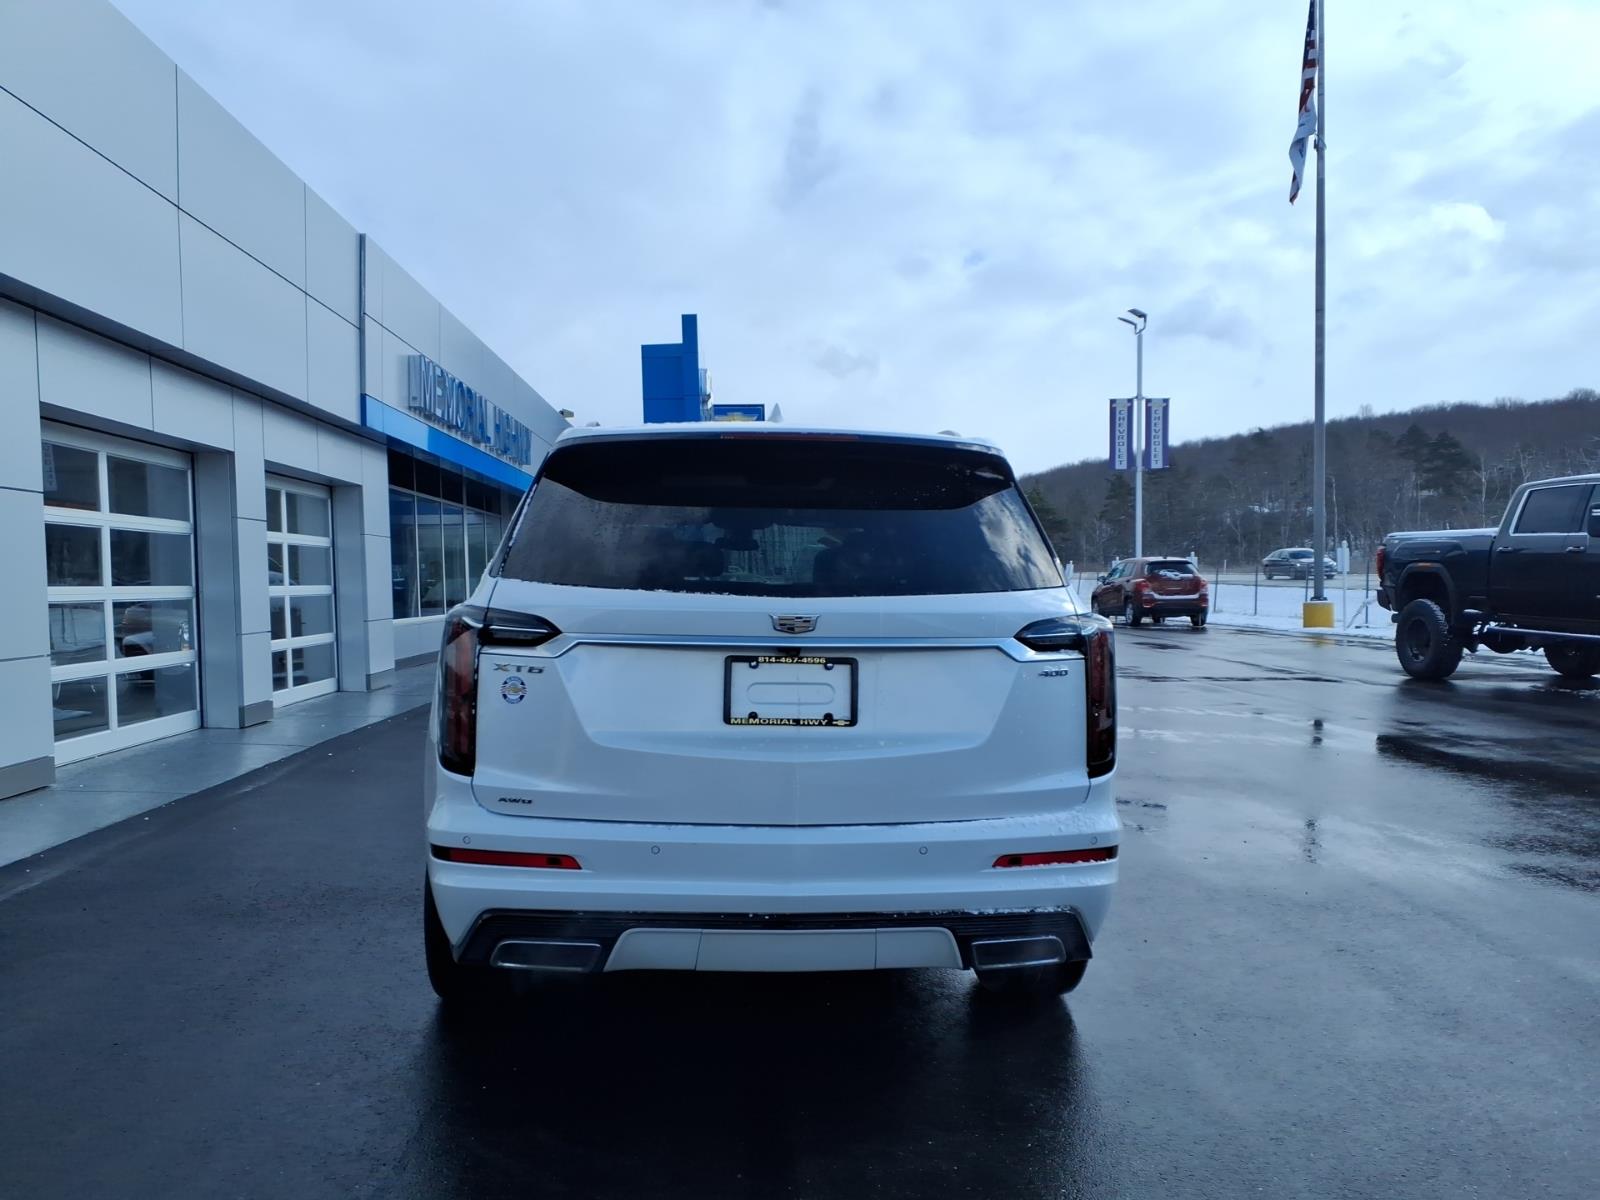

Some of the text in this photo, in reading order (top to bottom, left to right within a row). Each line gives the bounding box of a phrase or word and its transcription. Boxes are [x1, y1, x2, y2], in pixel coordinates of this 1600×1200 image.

[411, 355, 491, 444] MEMORIAL
[1117, 409, 1126, 465] CHEVROLET
[1152, 409, 1161, 465] CHEVROLET
[757, 656, 827, 664] 814-467-4596
[493, 663, 546, 674] XT6
[1038, 668, 1069, 677] 400
[730, 717, 829, 726] MEMORIAL HWY
[497, 797, 532, 805] AWD
